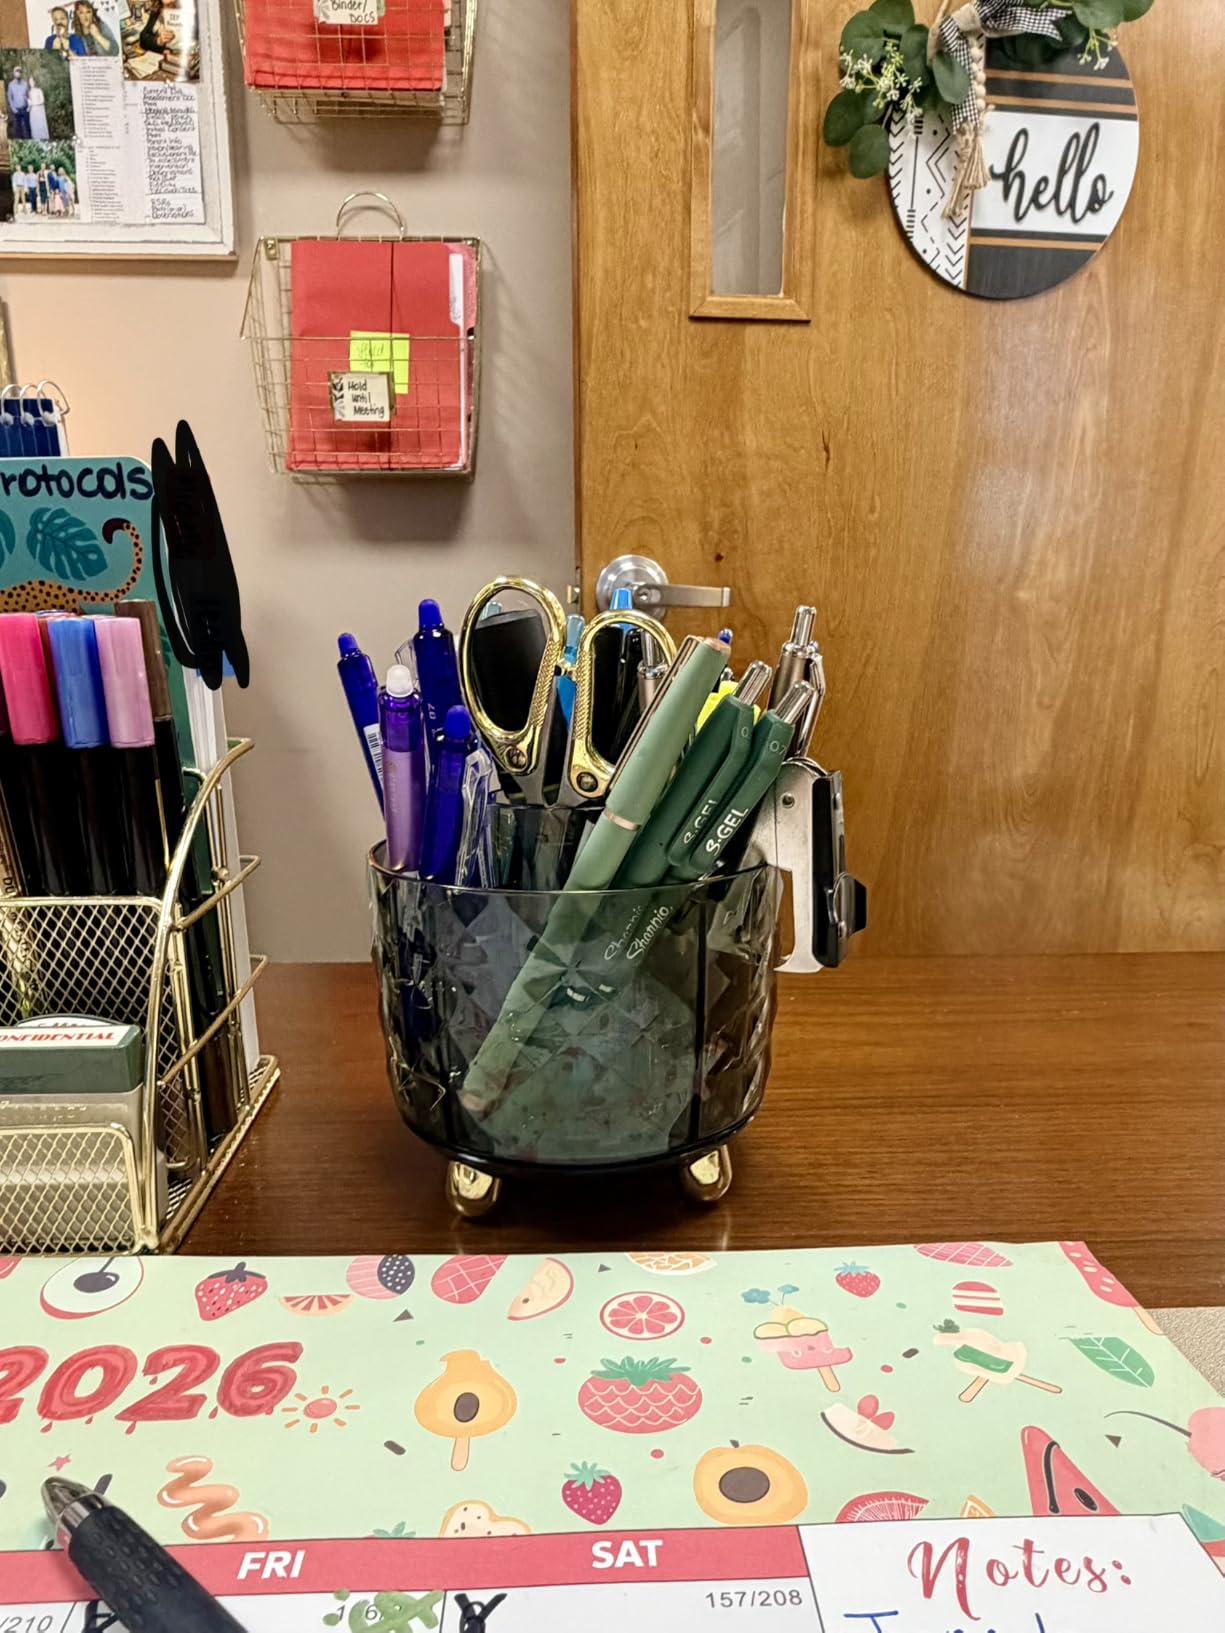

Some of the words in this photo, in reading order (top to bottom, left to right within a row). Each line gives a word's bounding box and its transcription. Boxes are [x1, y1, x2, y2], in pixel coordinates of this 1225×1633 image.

[989, 122, 1114, 224] hello
[347, 379, 368, 391] Hold
[0, 1341, 304, 1422] 2026
[237, 1550, 306, 1580] FRI
[591, 1540, 664, 1569] SAT
[907, 1537, 1132, 1621] Notes:
[705, 1589, 803, 1608] 157/208
